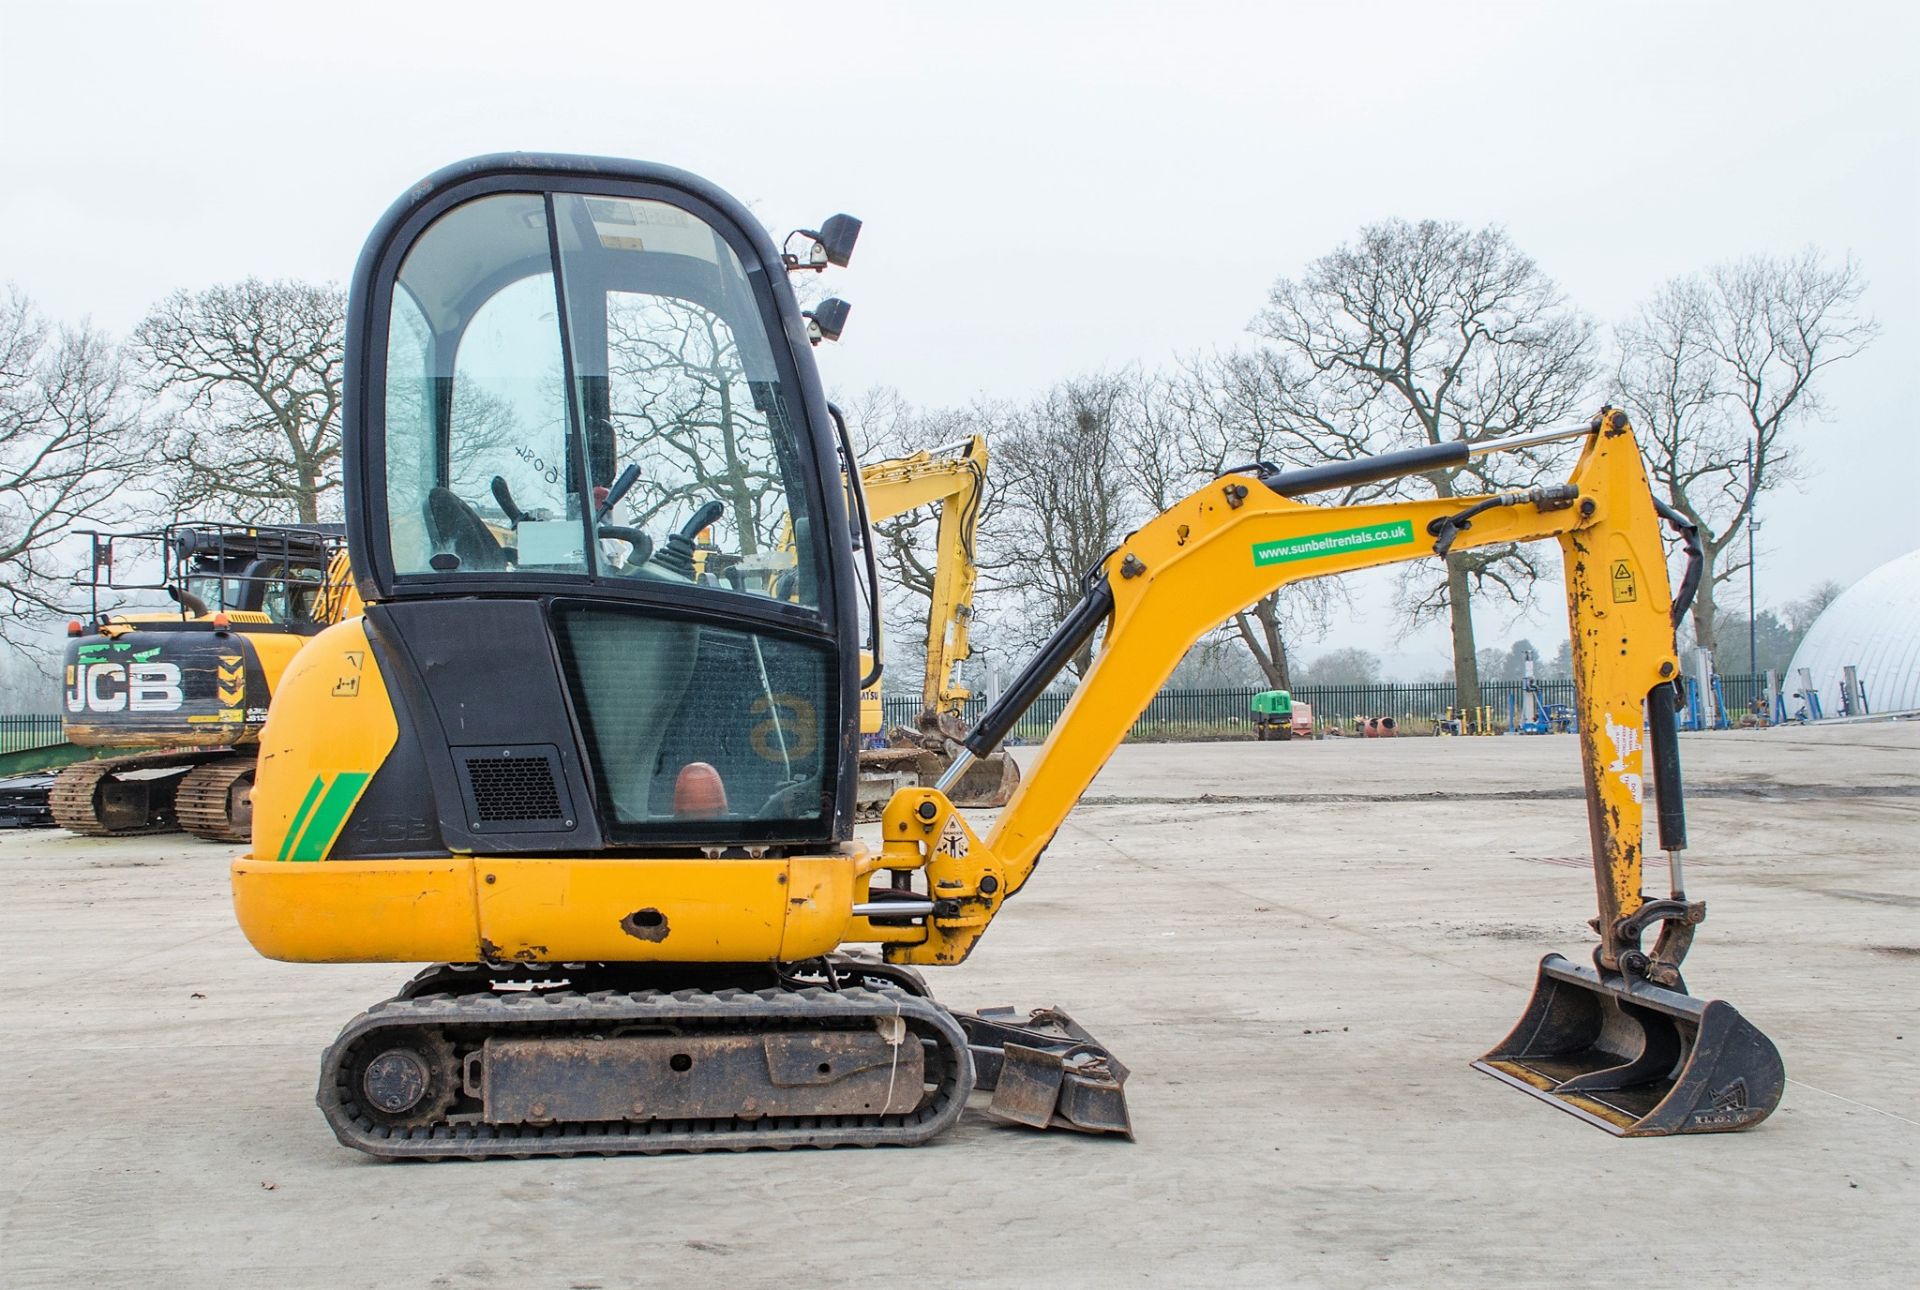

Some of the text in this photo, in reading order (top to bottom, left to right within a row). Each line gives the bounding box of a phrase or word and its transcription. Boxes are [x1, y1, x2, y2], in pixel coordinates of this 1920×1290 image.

[1259, 526, 1406, 560] www.sunbeltrentals.co.uk
[66, 663, 184, 712] JCB
[860, 689, 879, 701] ATSU
